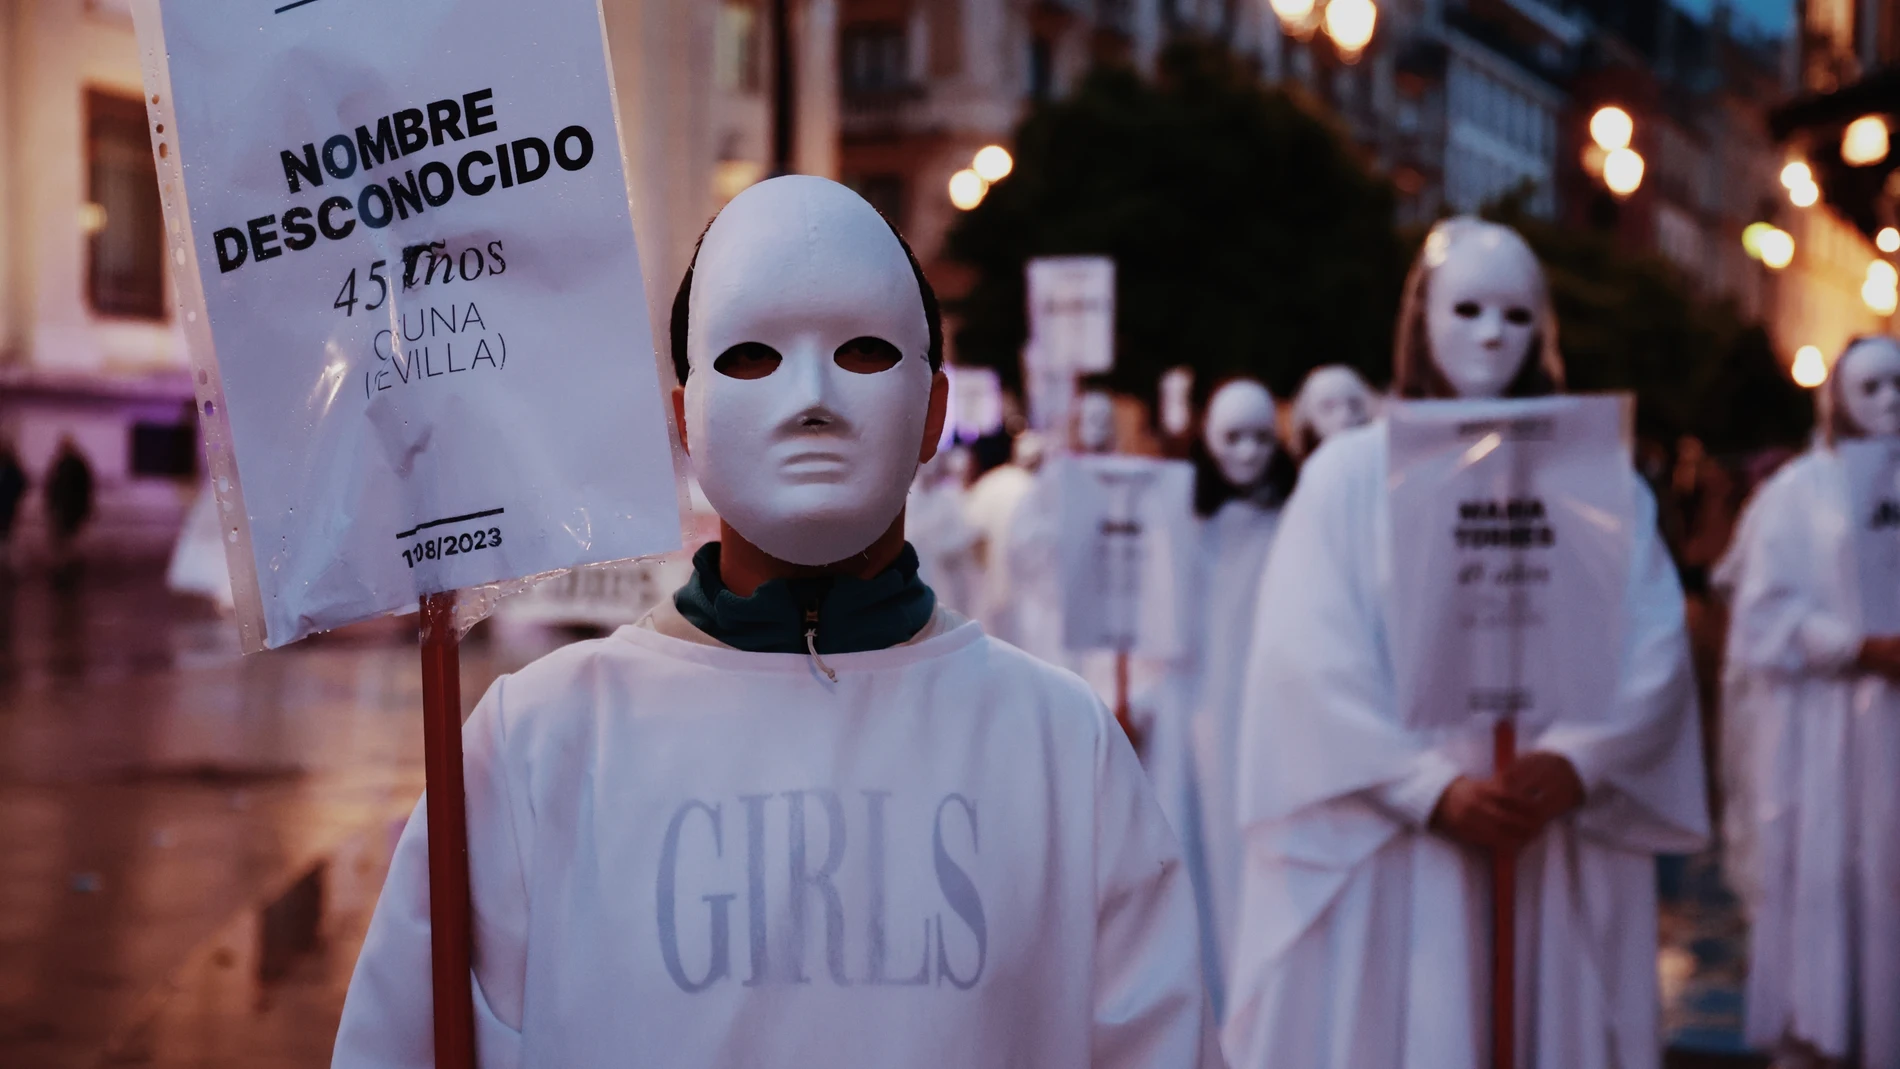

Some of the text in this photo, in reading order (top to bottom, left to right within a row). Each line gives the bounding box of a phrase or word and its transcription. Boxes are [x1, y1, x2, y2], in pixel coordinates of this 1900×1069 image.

[212, 125, 595, 274] DESCONOCIDO
[281, 87, 498, 194] NOMBRE
[333, 259, 388, 317] 45
[656, 787, 988, 994] GIRLS
